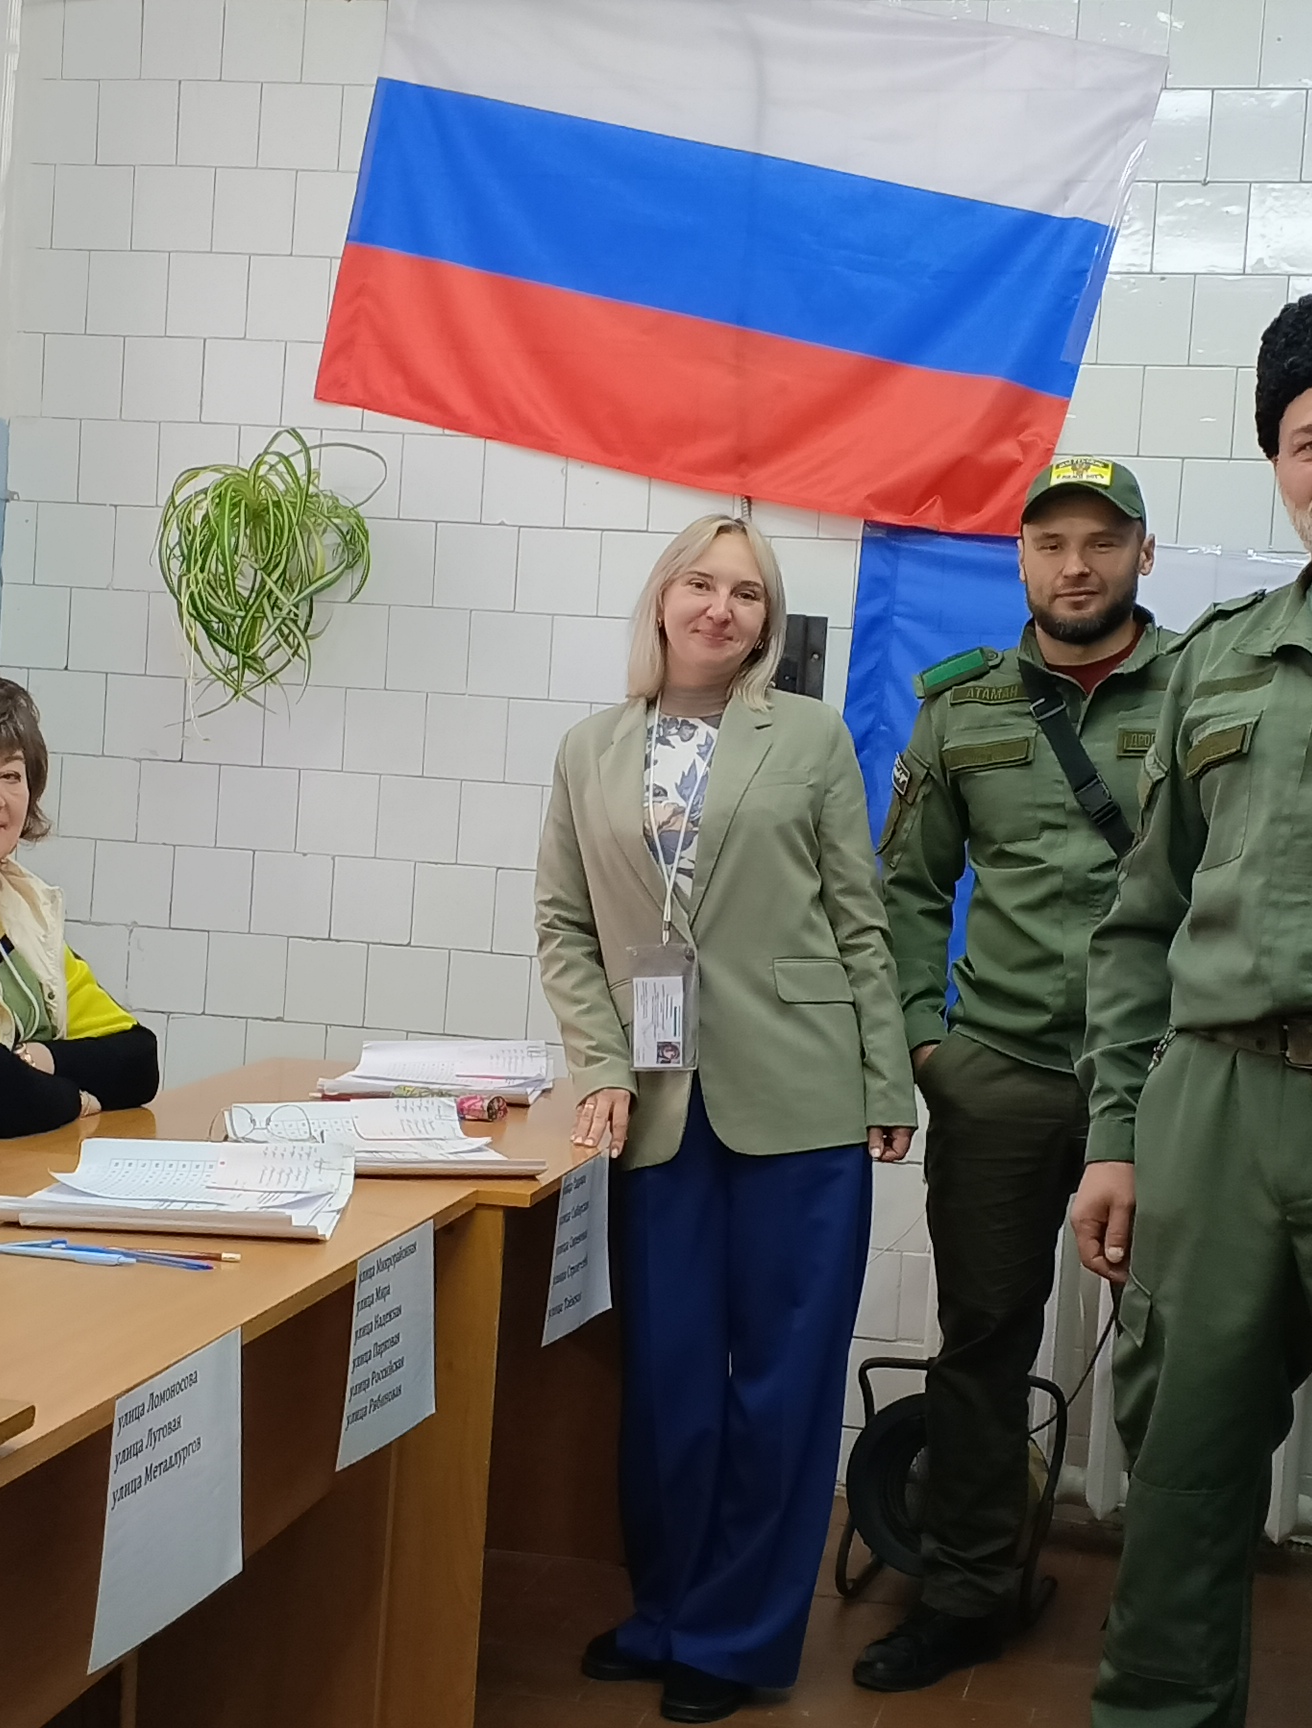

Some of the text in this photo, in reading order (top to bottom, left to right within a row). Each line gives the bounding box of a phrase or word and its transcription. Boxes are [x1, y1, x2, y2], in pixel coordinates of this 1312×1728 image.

[966, 685, 1018, 700] АТАМАН
[117, 1370, 198, 1437] улица Ломоносова
[111, 1436, 202, 1511] улица Металлургов
[114, 1415, 182, 1474] улица Луговая
